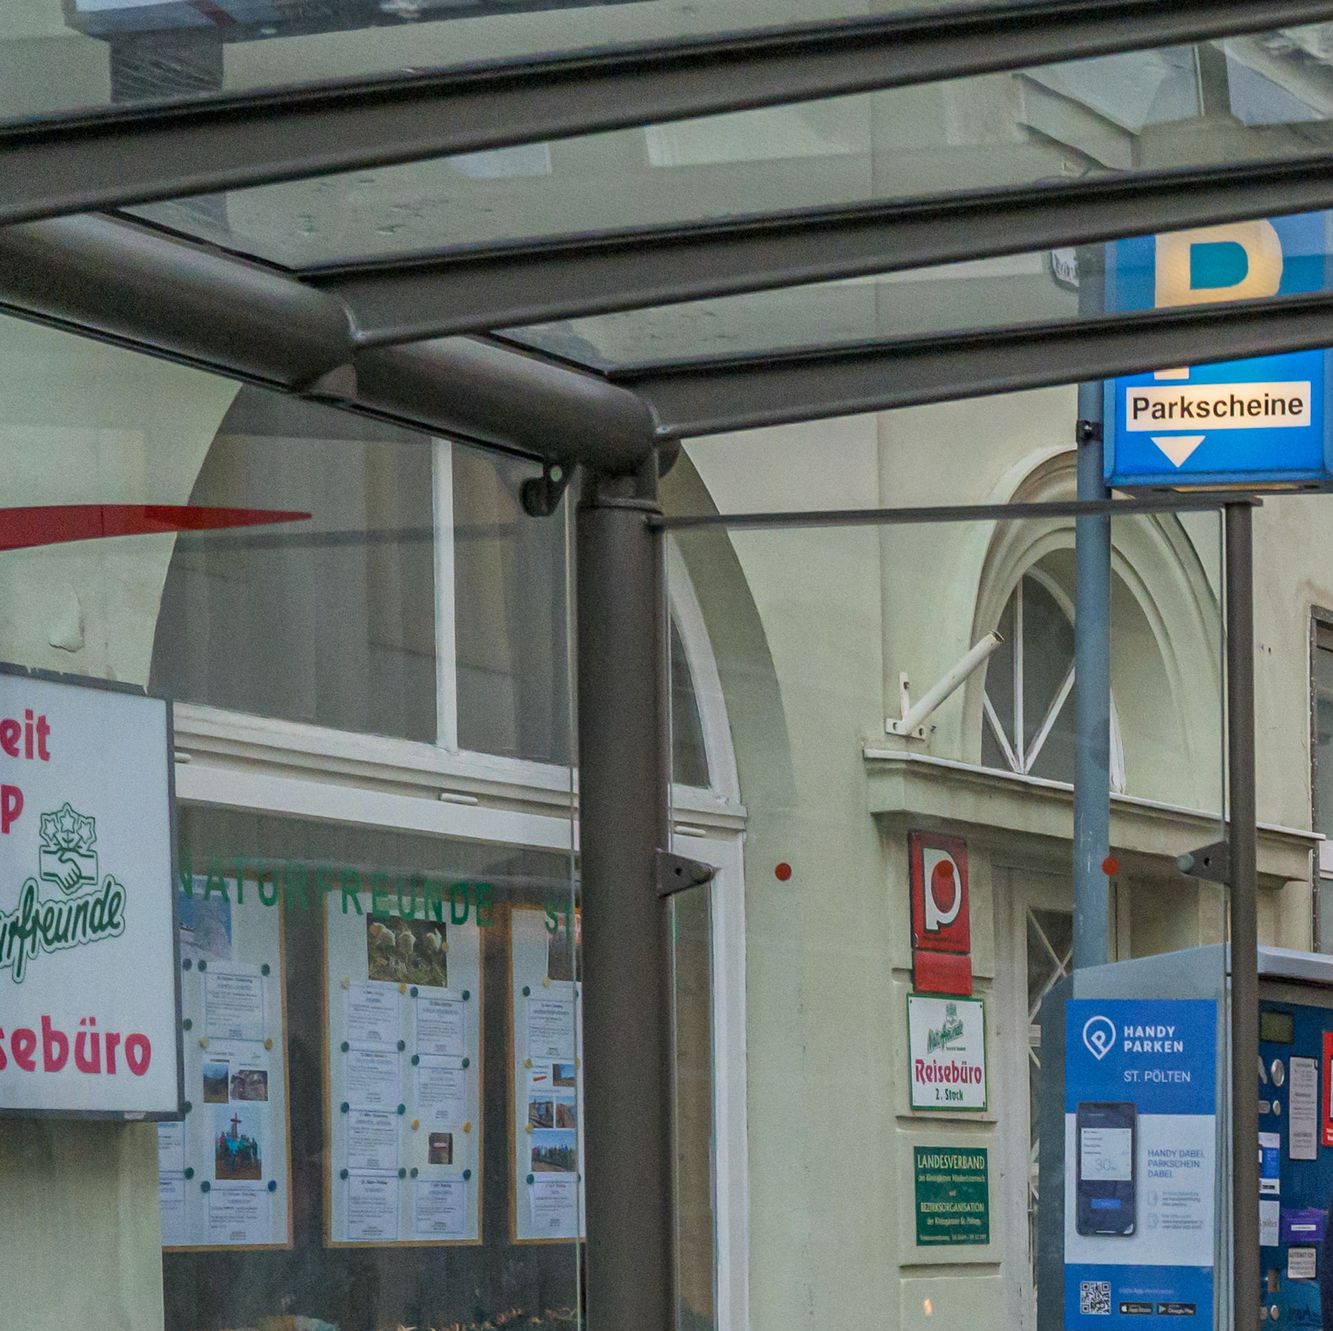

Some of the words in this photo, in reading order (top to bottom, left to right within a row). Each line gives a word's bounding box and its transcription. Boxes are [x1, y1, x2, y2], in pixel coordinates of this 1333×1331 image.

[1132, 393, 1304, 420] Parkscheine
[178, 848, 494, 927] NATURFREUNDE
[1123, 1026, 1176, 1038] HANDY
[1123, 1040, 1184, 1053] PARKEN
[914, 1058, 983, 1086] Reisebüro
[1123, 1070, 1142, 1083] ST.
[1144, 1068, 1191, 1083] PÖLTEN
[945, 1088, 964, 1101] Stock
[1147, 1150, 1176, 1158] HANDY
[917, 1154, 986, 1170] LANDESVERBAND
[1147, 1159, 1200, 1169] PARKSCHEIN
